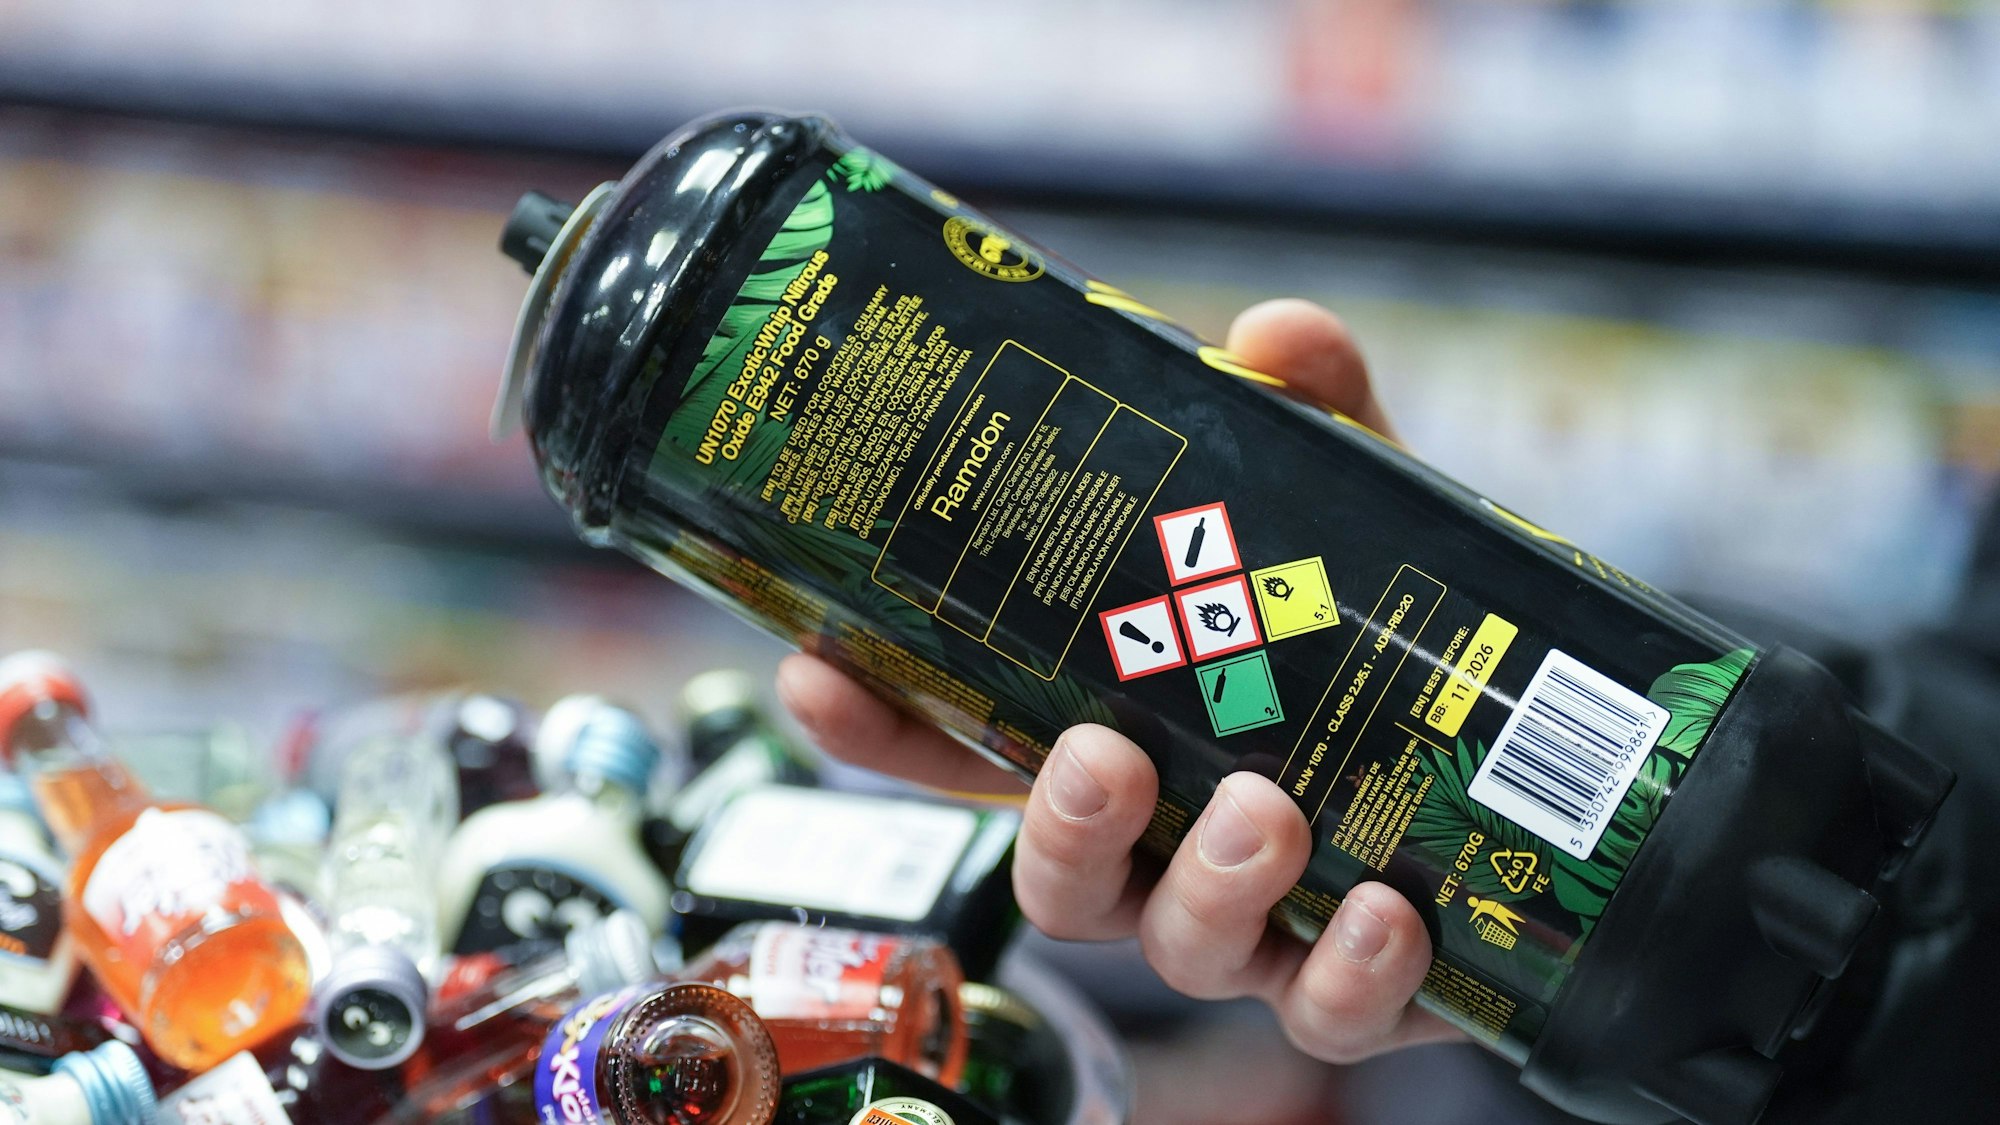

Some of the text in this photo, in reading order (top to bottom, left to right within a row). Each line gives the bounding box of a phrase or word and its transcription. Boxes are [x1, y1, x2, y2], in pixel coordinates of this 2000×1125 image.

[695, 248, 833, 466] UN1070 ExoticWhip Nitrous
[719, 270, 840, 462] Oxide E942 Food Grade
[761, 284, 890, 502] [EN] TO BE USED FOR COCKTAILS, CULINARY
[768, 333, 833, 422] NET: 670 g
[777, 302, 889, 491] DISHES, CAKES AND WHIPPED CREAM.
[780, 493, 797, 515] [FR]
[793, 442, 821, 486] UTILISER
[815, 413, 836, 443] POUR
[831, 392, 847, 414] LES
[842, 338, 881, 394] COCKTAILS,
[875, 320, 893, 340] LES
[887, 294, 911, 322] PLATS
[786, 466, 820, 524] CULINAIRES,
[814, 446, 830, 468] LES
[823, 399, 856, 448] GÂTEAUX
[851, 385, 865, 401] ET
[859, 372, 873, 387] LA
[802, 309, 929, 523] [DE] FÜR COCKTAILS, KULINARISCHE GERICHTE,
[824, 507, 841, 530] [ES]
[834, 481, 853, 509] PARA
[846, 461, 863, 484] SER
[857, 425, 883, 462] USADO
[877, 410, 891, 427] EN
[918, 324, 945, 359] PLATOS
[825, 341, 919, 496] TORTEN UND ZUM SCHLAGSAHNE
[837, 337, 949, 524] CULINARIOS, PASTELES, Y CREMA BATIDA
[849, 345, 959, 530] [IT] DA UTILIZZARE PER COCKTAIL, PIATTI
[858, 347, 973, 540] GASTRONOMICI, TORTE E PANNA MONTATA
[913, 392, 985, 511] Officially produced by Ramdon
[929, 405, 1011, 522] Ramdon
[1040, 452, 1055, 472] Malta
[969, 440, 1015, 512] www.ramdon.com
[972, 519, 992, 549] Ramdon
[987, 505, 1000, 521] Ltd.
[995, 486, 1011, 507] Quad
[1006, 463, 1025, 488] Central
[1028, 433, 1043, 452] Level
[1010, 476, 1029, 502] Central
[1024, 447, 1047, 477] Business
[1026, 471, 1093, 583] [EN] NON-REFILLABLE CYLINDER
[1033, 470, 1108, 597] [FR] CYLINDER NON RECHARGEABLE
[1043, 474, 1121, 605] [DE] NICHT ZYLINDER
[1059, 490, 1126, 601] [ES] CILINDRO NO RECARGABLE
[1069, 495, 1138, 609] [IT] BOMBOLA NON RICARICABILE
[1313, 603, 1329, 620] 5.1
[1263, 706, 1275, 716] 2
[1292, 765, 1315, 797] UN.Nr
[1307, 741, 1328, 768] 1070
[1326, 693, 1355, 733] CLASS
[1347, 661, 1374, 696] 2.2/5.1
[1409, 624, 1469, 718] [EN] BEST BEFORE:
[1430, 642, 1494, 723] BB: 11/2026
[1331, 761, 1381, 847] [FR] CONSOMMER DE
[1349, 736, 1419, 857] [DE] MINDESTENS HALTBAR BIS:
[1358, 755, 1420, 862] [ES] ANTES DE:
[1365, 772, 1386, 803] AVANT:
[1367, 791, 1412, 867] [IT] DA CONSUMARSI
[1376, 773, 1435, 872] PREFERIBILMENTE ENTRO:
[1569, 720, 1652, 848] 5 350742 999861
[1434, 830, 1485, 907] NET: 670G
[1505, 857, 1525, 880] 40
[1531, 872, 1550, 893] FE
